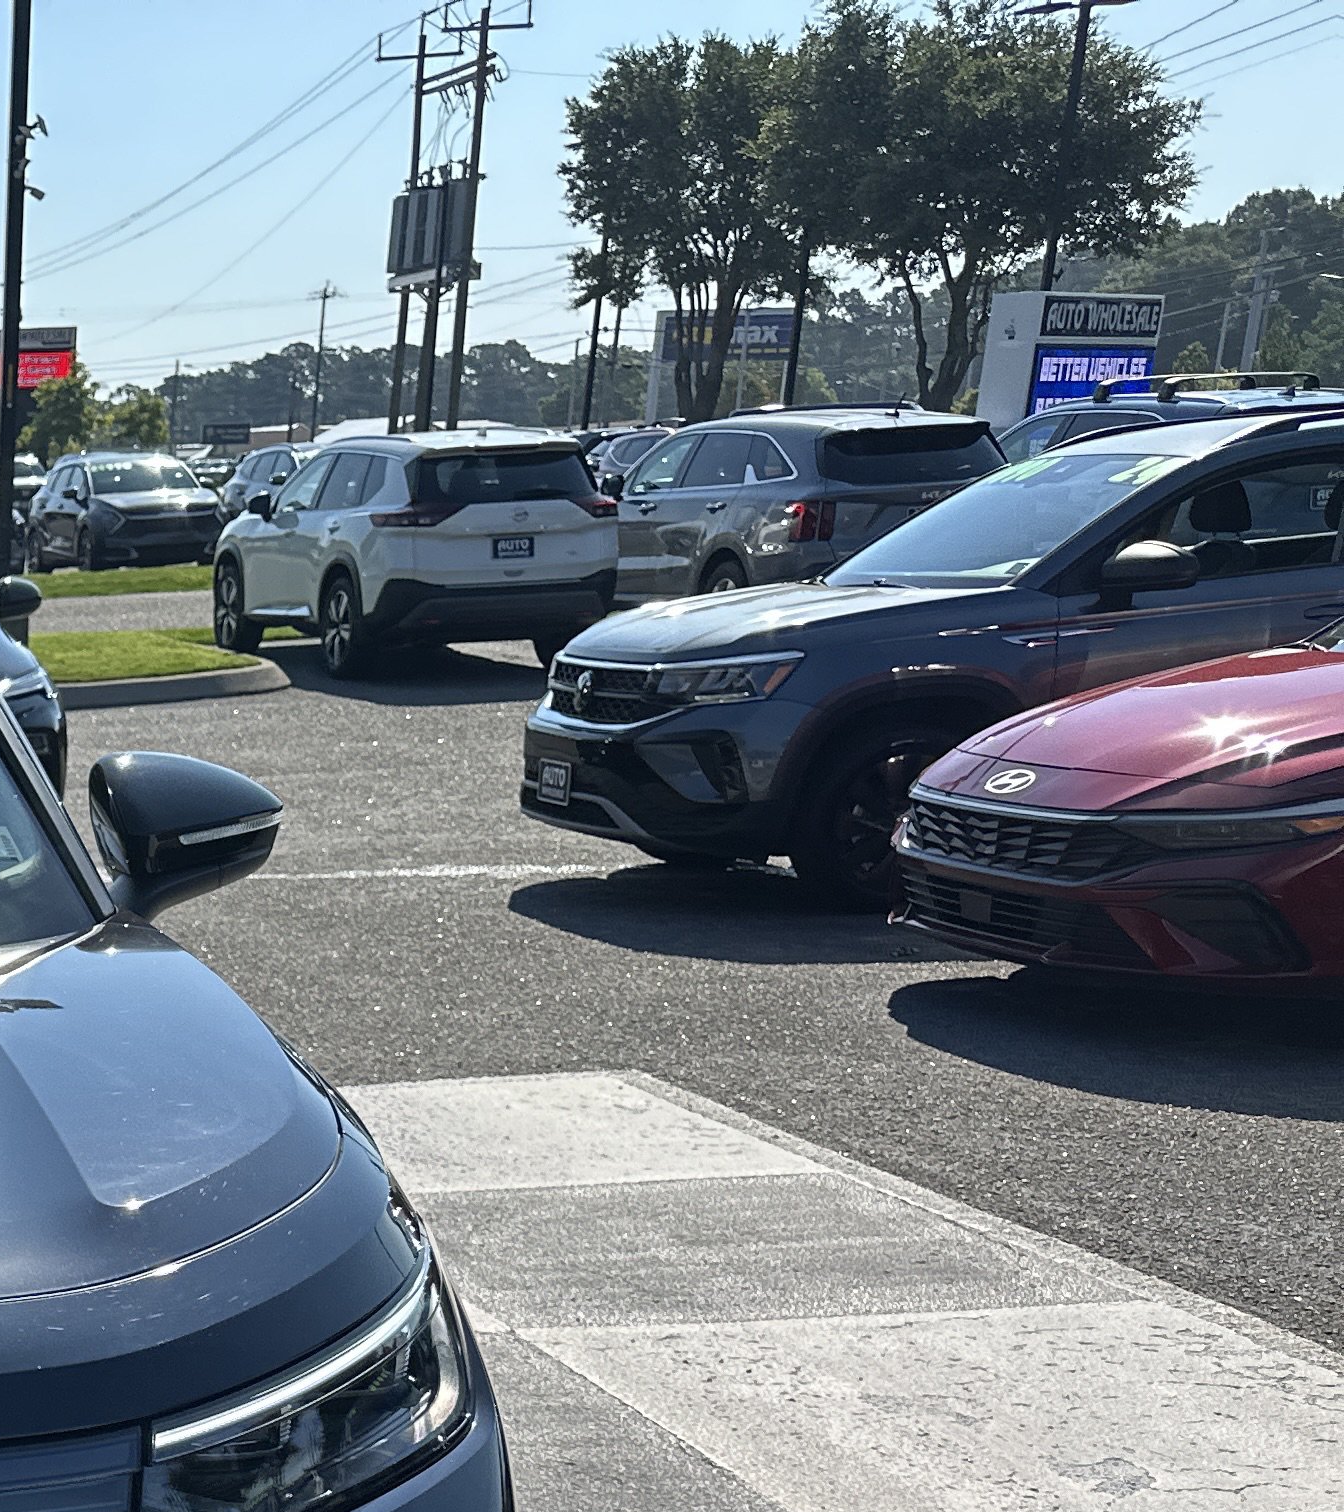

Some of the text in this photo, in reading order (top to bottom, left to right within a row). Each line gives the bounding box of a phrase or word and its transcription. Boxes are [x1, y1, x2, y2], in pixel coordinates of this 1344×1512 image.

[1046, 302, 1160, 333] AUTO WHOLESALE
[1040, 357, 1147, 382] BETTER VEHICLES
[497, 538, 530, 552] AUTO
[542, 766, 566, 787] AUTO
